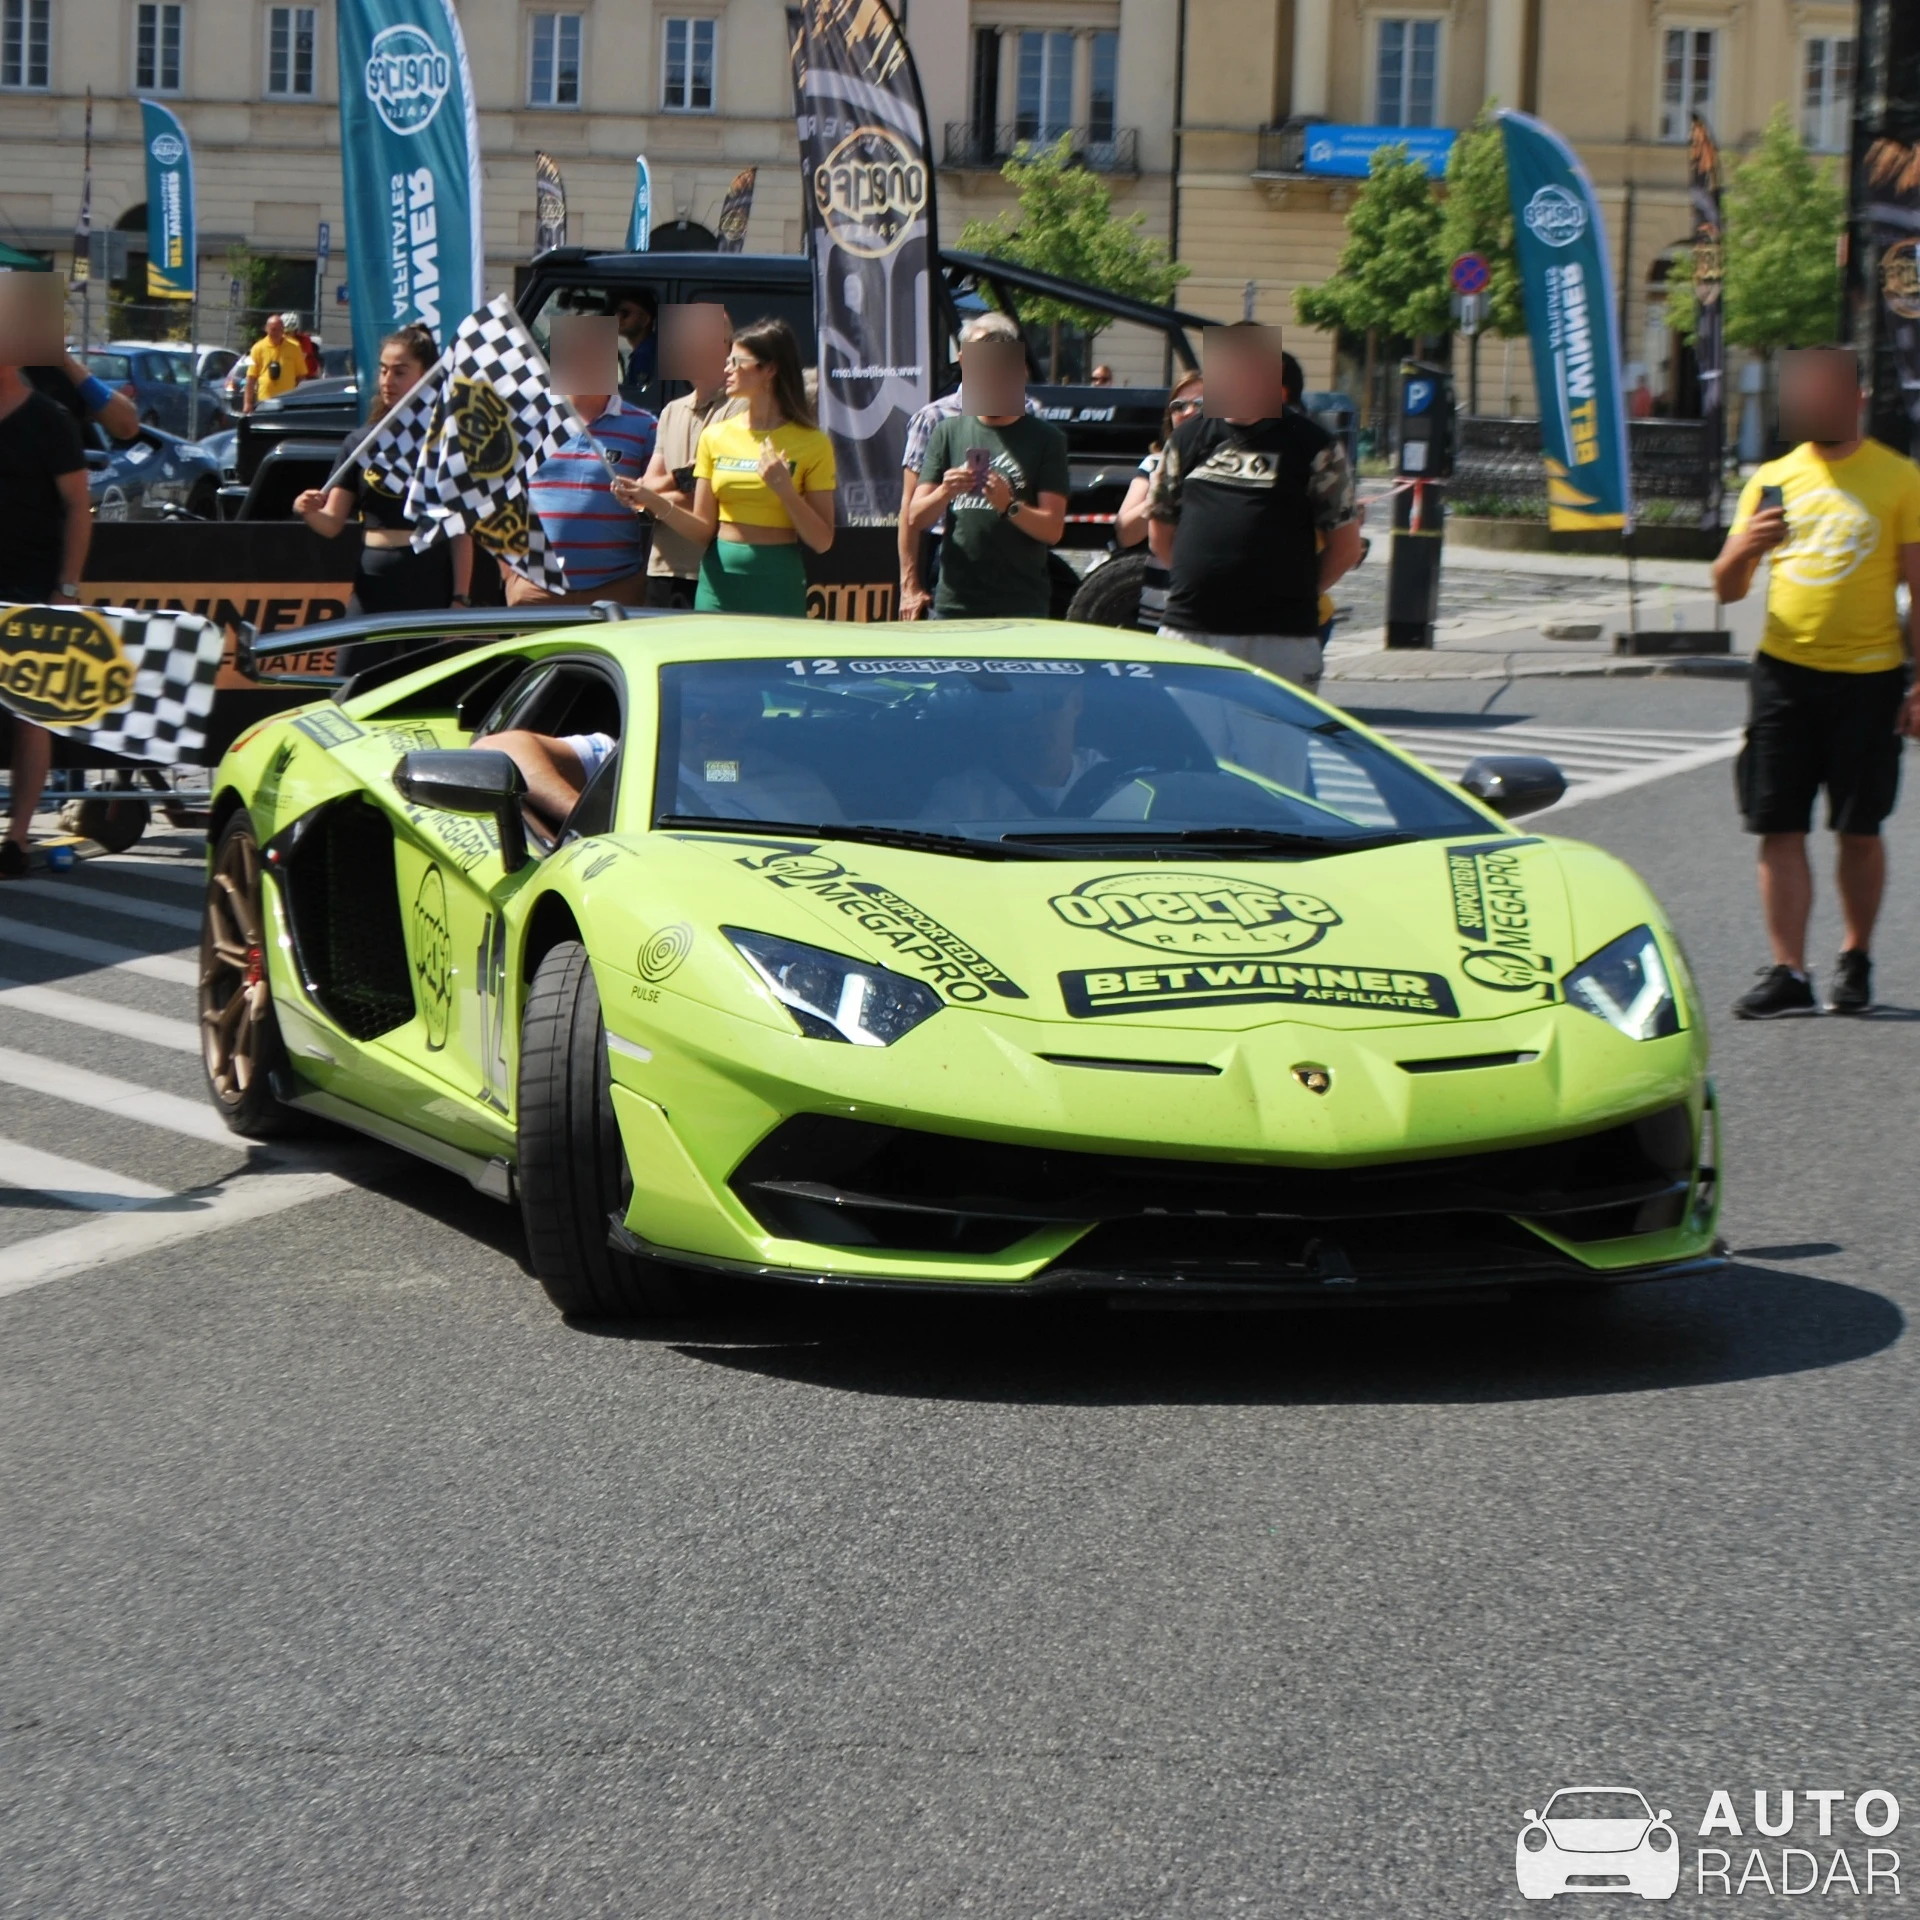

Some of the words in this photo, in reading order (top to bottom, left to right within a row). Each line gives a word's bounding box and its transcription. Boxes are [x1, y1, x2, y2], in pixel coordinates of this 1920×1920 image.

[1408, 381, 1429, 410] P
[786, 659, 840, 675] 12
[1100, 661, 1154, 678] 12
[1452, 868, 1484, 929] SUPPORTED
[870, 891, 979, 963] SUPPORTED
[972, 962, 1007, 983] BY
[1153, 931, 1293, 945] RALLY
[630, 985, 661, 1004] PULSE
[1302, 988, 1439, 1010] AFFILIATES
